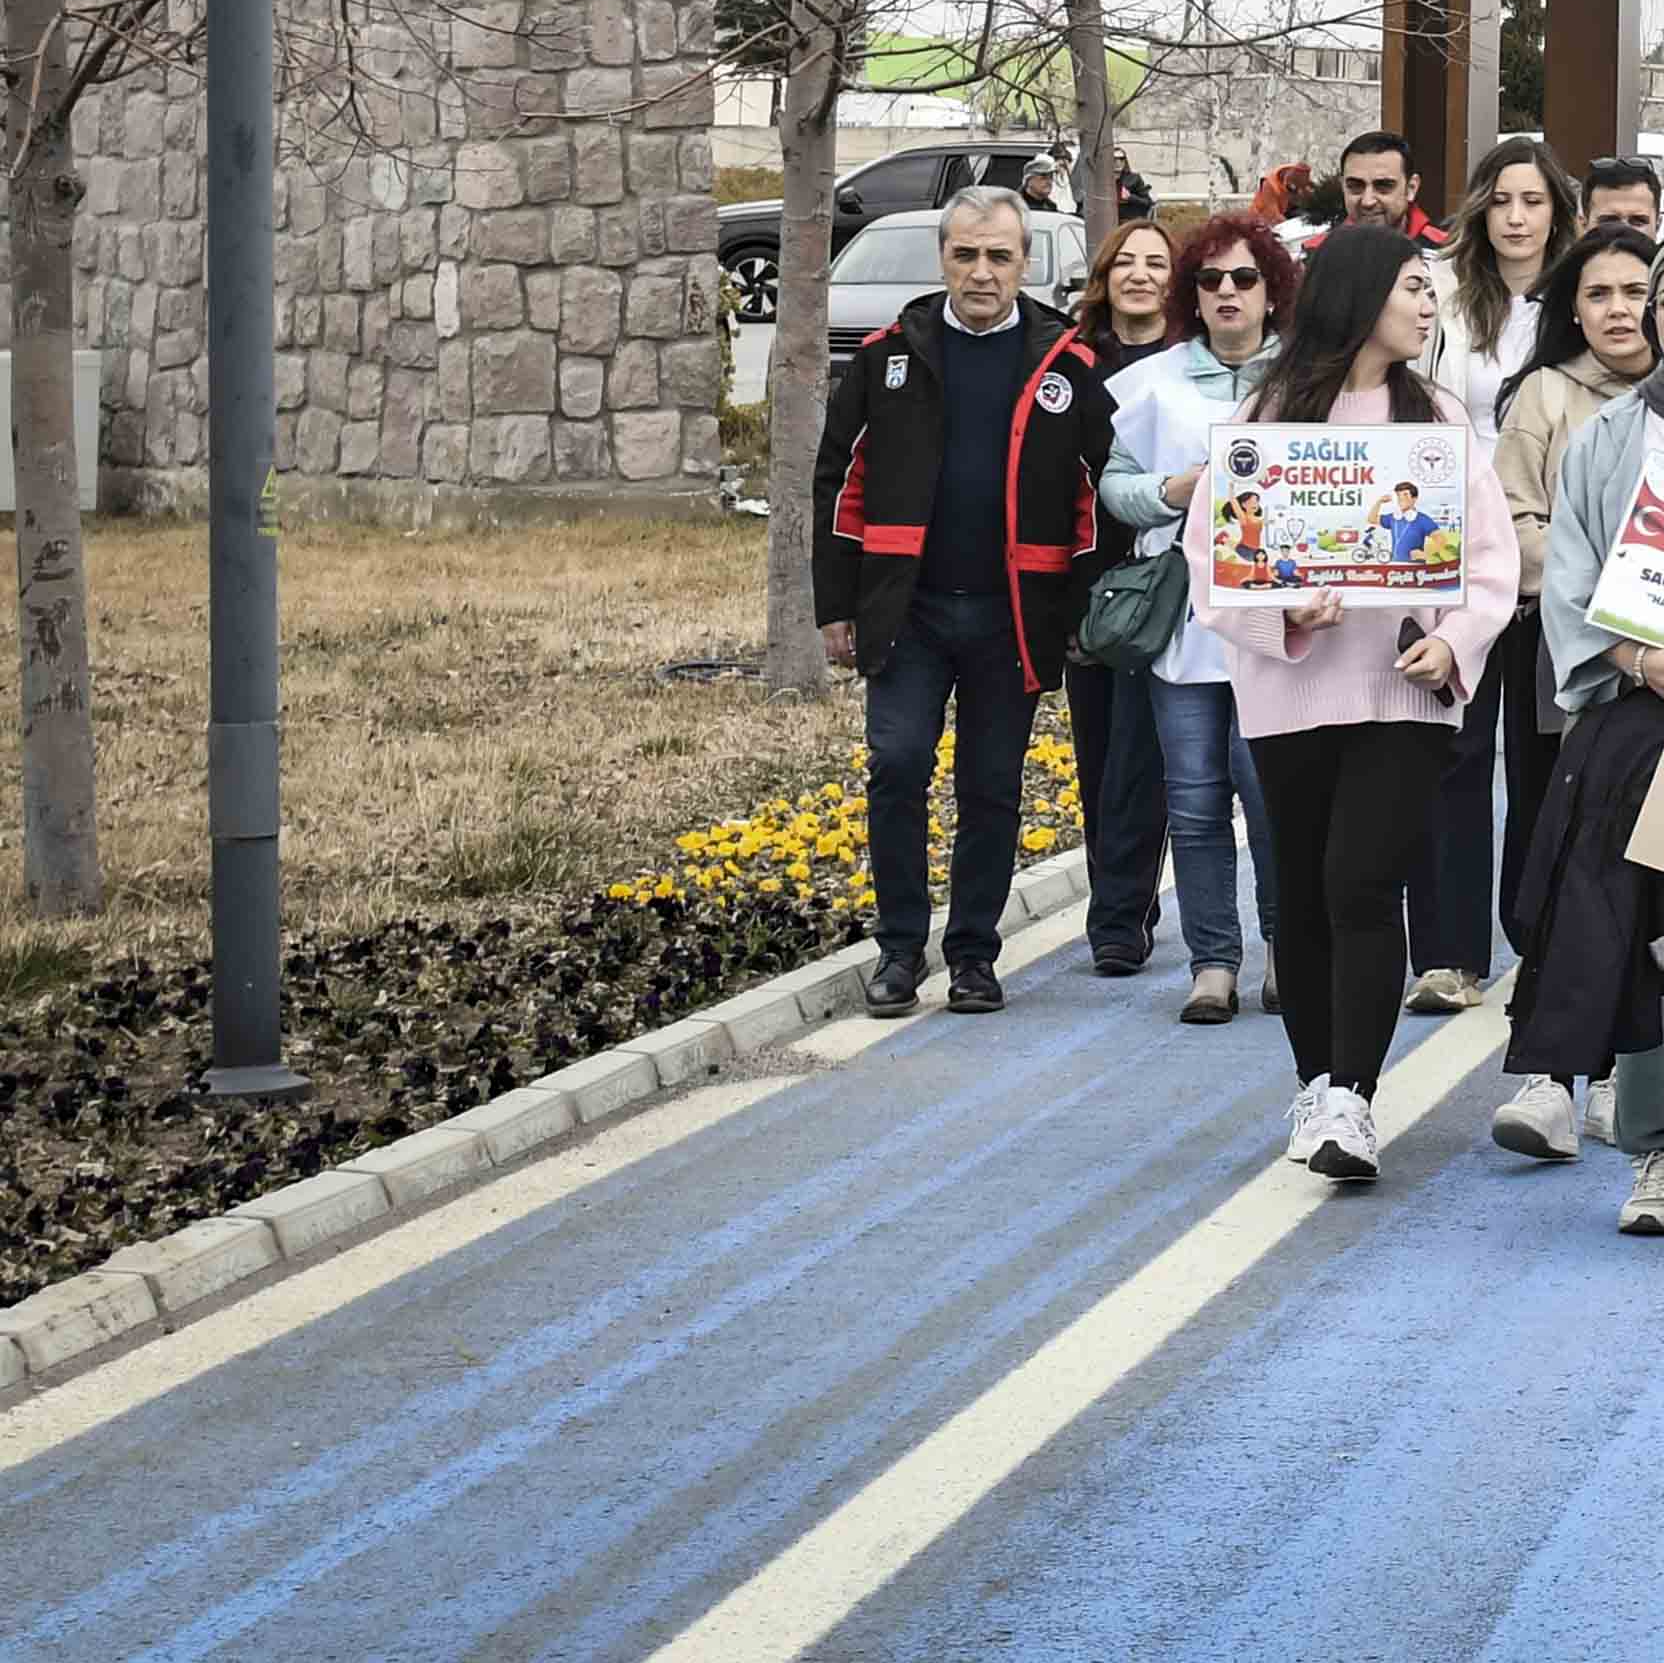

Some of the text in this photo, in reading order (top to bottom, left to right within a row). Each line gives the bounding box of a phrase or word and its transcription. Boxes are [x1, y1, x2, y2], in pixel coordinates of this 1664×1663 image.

[1287, 438, 1369, 462] SAĞLIK
[1283, 463, 1375, 489] GENÇLİK
[1290, 489, 1363, 507] MECLİSİ
